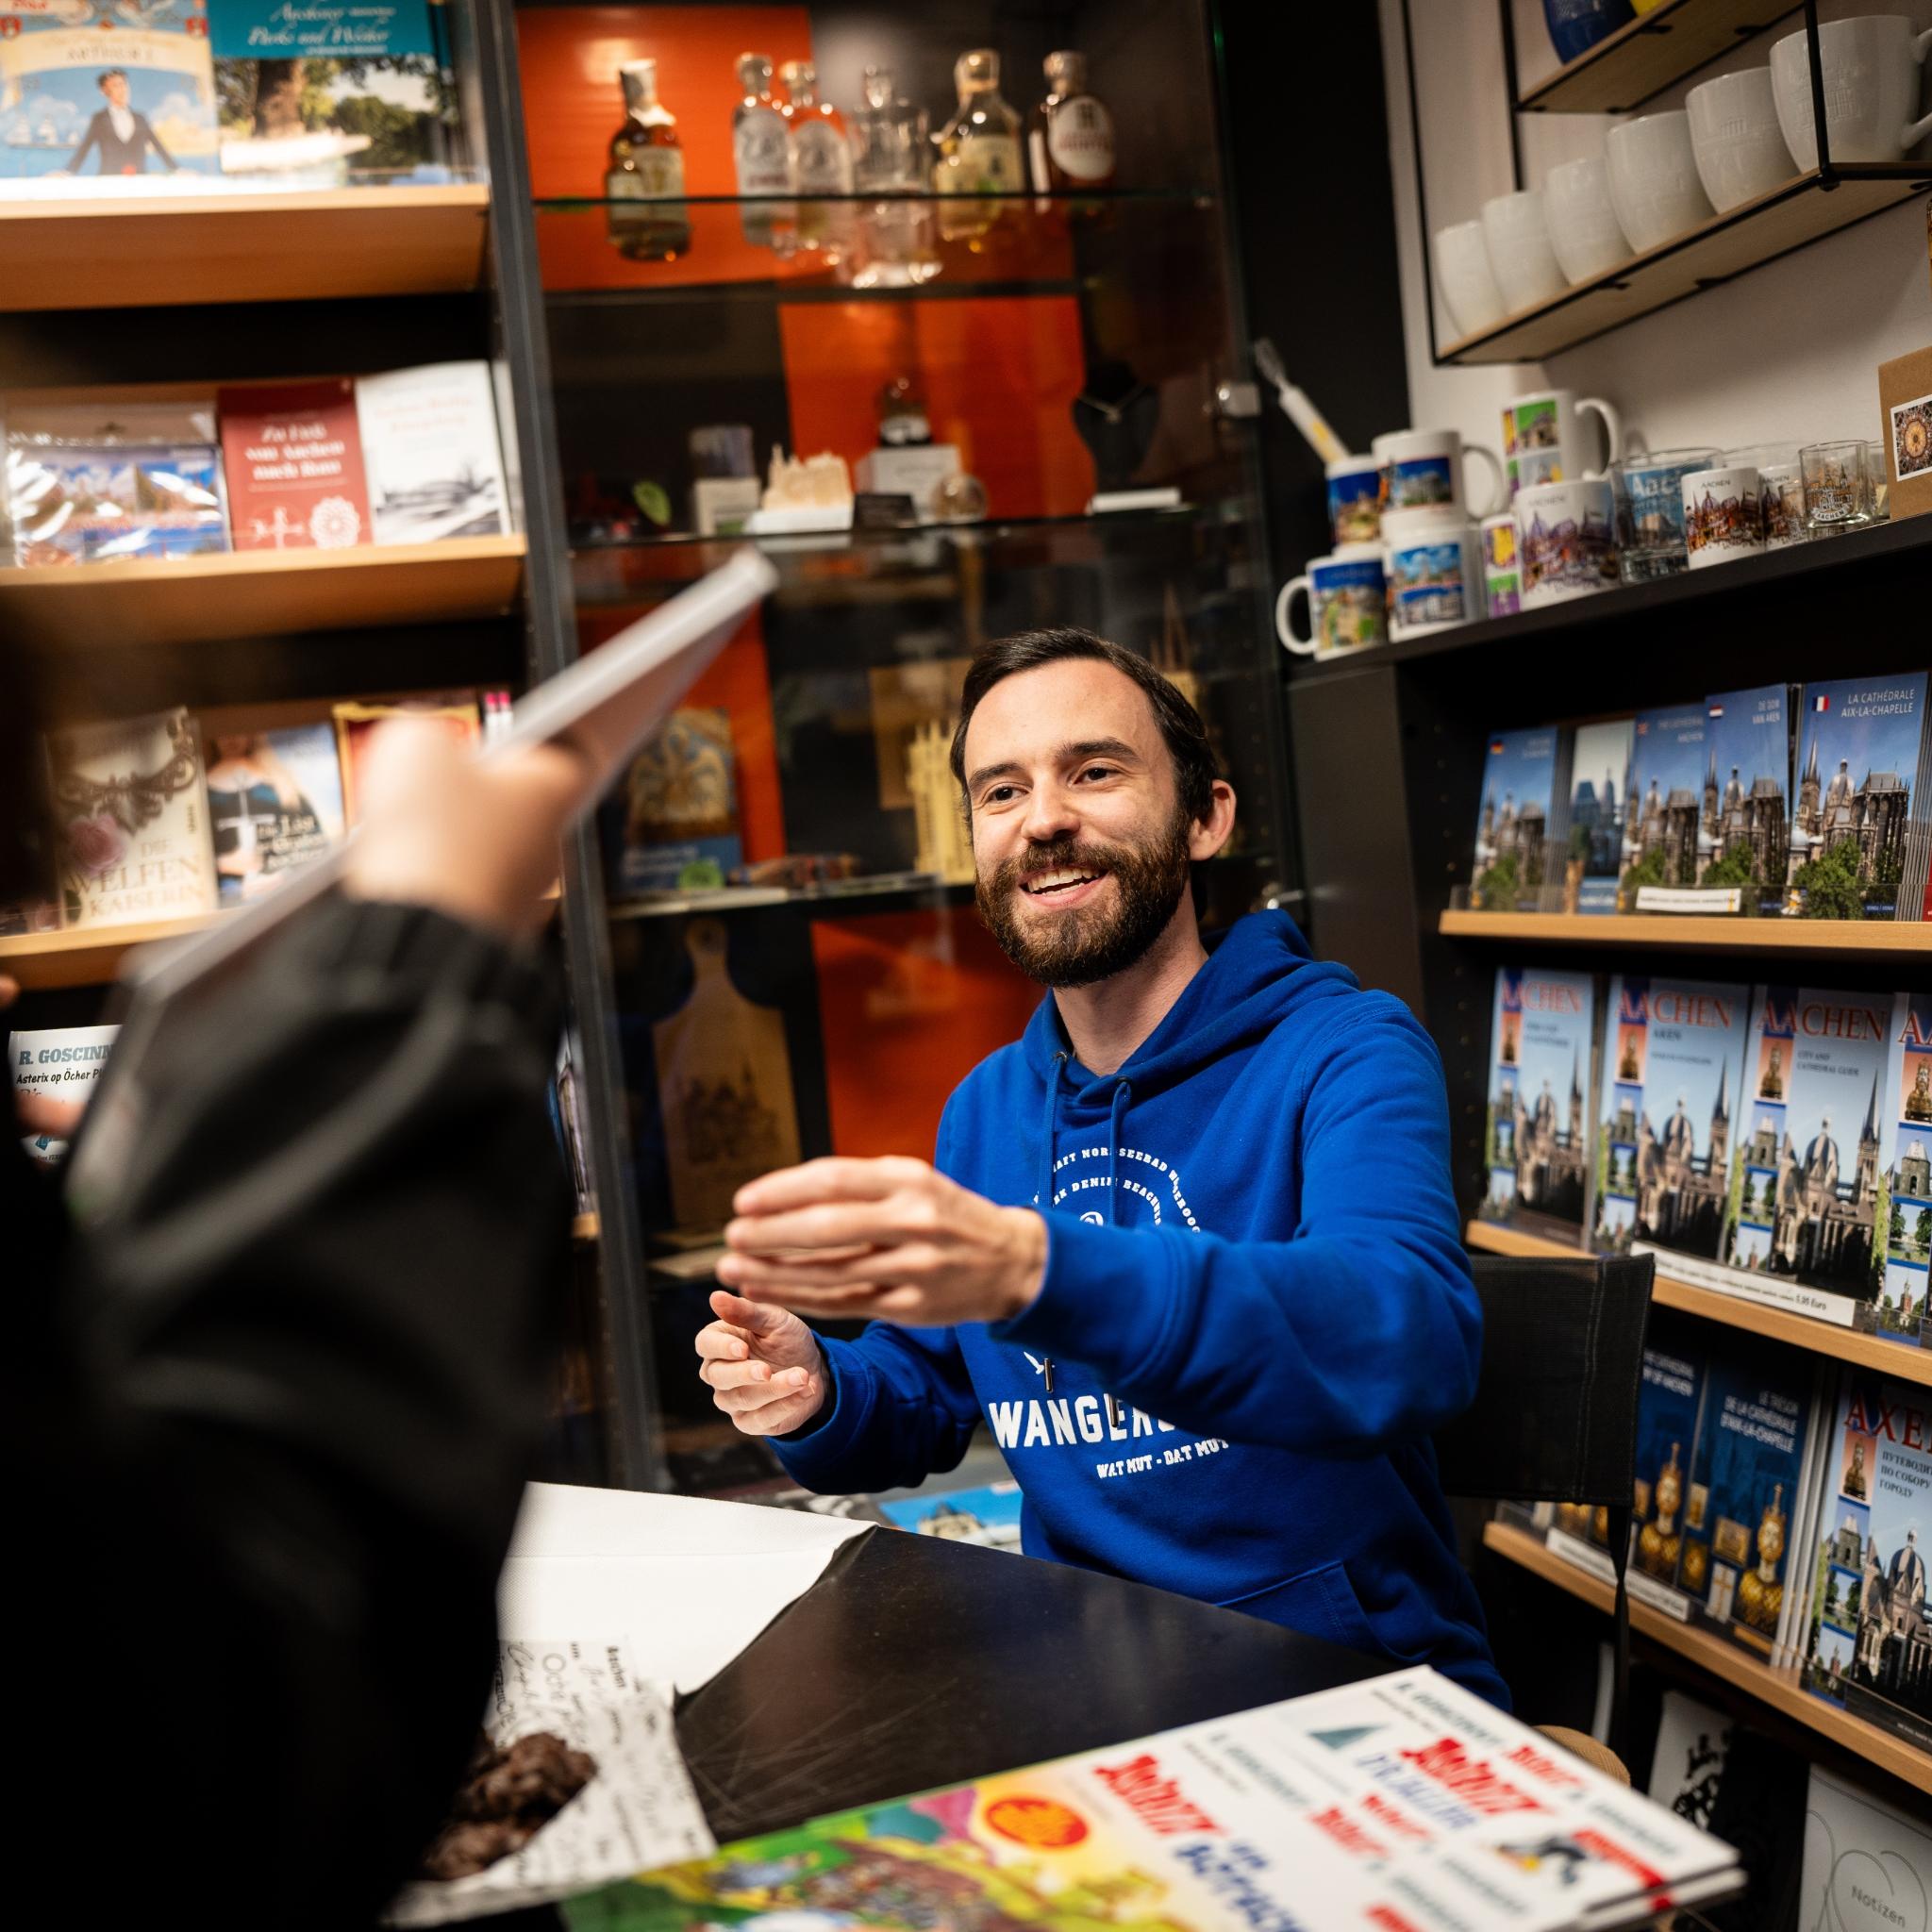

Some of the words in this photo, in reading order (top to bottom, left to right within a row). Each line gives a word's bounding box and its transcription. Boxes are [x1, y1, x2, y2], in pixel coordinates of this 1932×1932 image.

[1847, 693, 1859, 706] LA
[1860, 688, 1915, 703] CATHÉDRALE
[1840, 702, 1914, 719] AIX-LA-CHAPELLE
[1499, 980, 1583, 1015] AACHEN
[1614, 990, 1734, 1030] AACHEN
[1756, 1000, 1888, 1042] AACHEN
[19, 1050, 34, 1066] R.
[38, 1043, 115, 1064] GOSCINN
[16, 1072, 49, 1085] Asterix
[50, 1073, 61, 1085] op
[63, 1067, 91, 1082] Öcher
[1810, 1297, 1827, 1311] Euro
[1096, 1460, 1124, 1479] WAT
[1125, 1454, 1153, 1474] MUT
[1162, 1443, 1192, 1466] DAT
[1882, 1450, 1932, 1477] ПУТЕВОДИ
[1879, 1478, 1913, 1499] ГОРОДУ
[1880, 1464, 1894, 1476] ПО
[1894, 1467, 1931, 1490] СОБОРУ
[1850, 1885, 1907, 1929] Notizen
